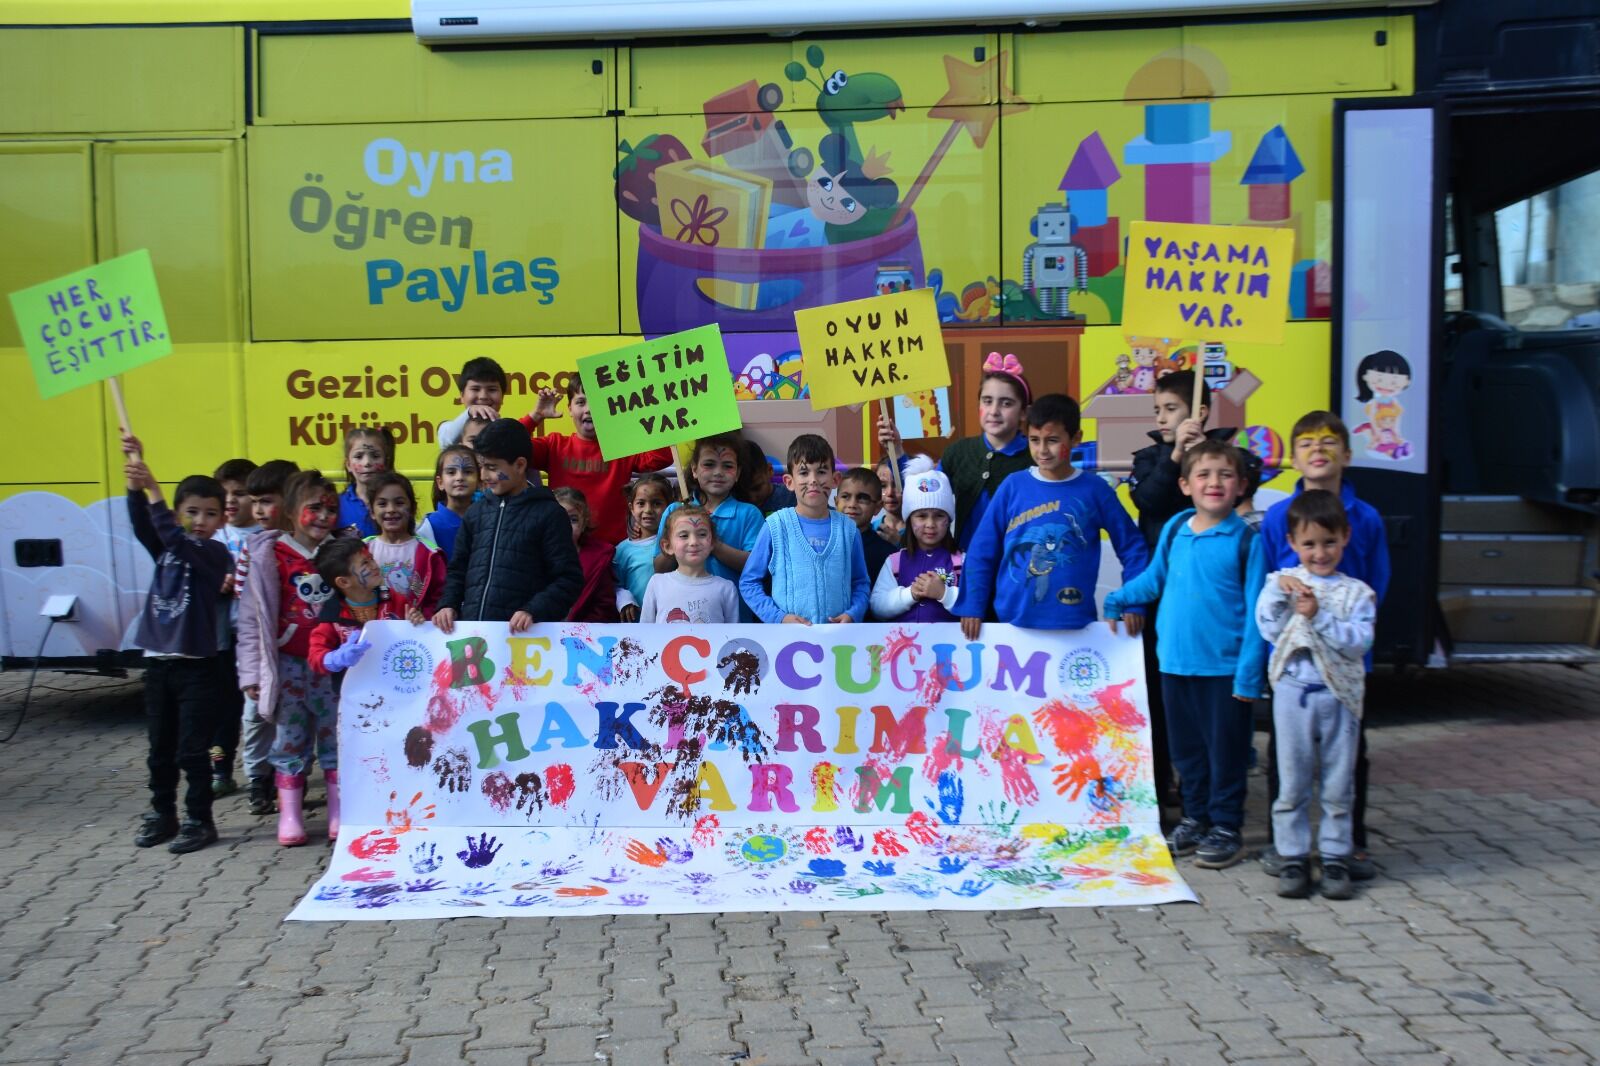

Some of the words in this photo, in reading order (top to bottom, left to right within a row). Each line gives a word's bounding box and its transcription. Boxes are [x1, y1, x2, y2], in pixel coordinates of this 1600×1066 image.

[364, 137, 513, 198] Oyna
[290, 172, 474, 250] Öğren
[1144, 236, 1269, 268] YAŞAMA
[48, 278, 104, 316] HER
[365, 249, 560, 313] Paylaş
[40, 296, 135, 348] ÇOCUK
[826, 307, 909, 337] OYUN
[1179, 302, 1243, 328] VAR.
[46, 319, 166, 375] EŞİTTİR.
[595, 344, 704, 389] EĞİTİM
[825, 335, 924, 367] HAKKIM
[286, 363, 409, 400] Gezici
[852, 362, 909, 388] VAR.
[639, 407, 698, 435] VAR.
[446, 635, 618, 690] BEN
[660, 630, 1053, 699] ÇOCUĞUM
[617, 759, 915, 814] VARIM
